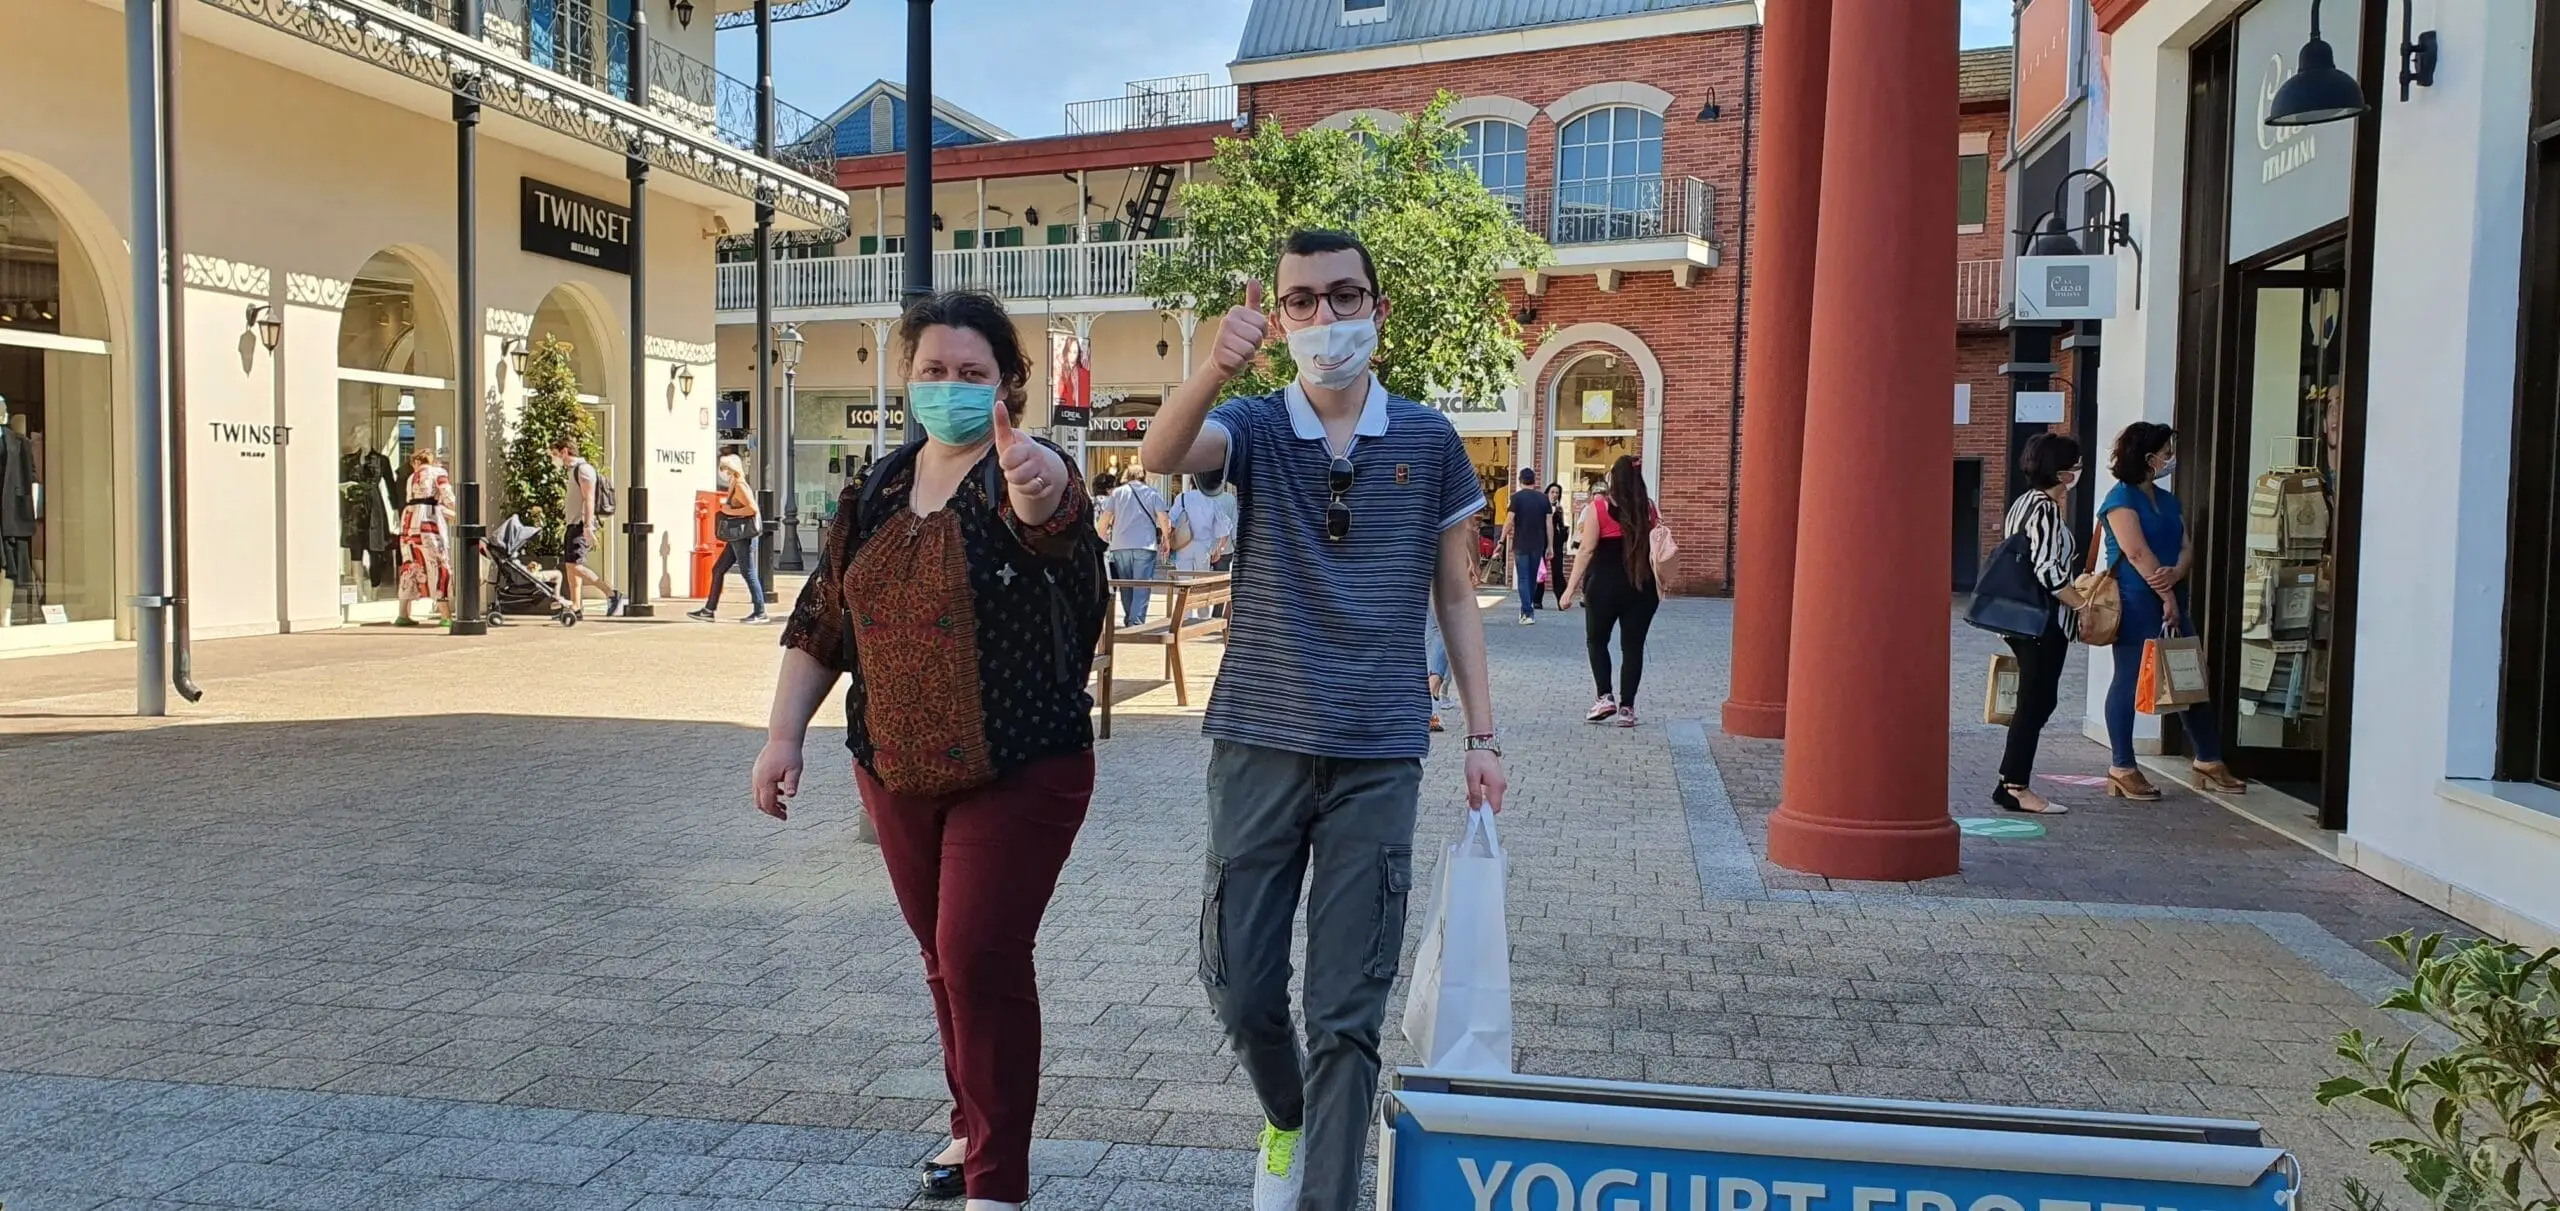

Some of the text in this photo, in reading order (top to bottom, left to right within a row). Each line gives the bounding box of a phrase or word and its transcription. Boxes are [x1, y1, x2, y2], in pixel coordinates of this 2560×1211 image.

[533, 189, 632, 246] TWINSET
[569, 241, 600, 258] MILANO
[2050, 275, 2082, 292] Casa
[1433, 396, 1507, 413] XCELA
[208, 421, 294, 446] TWINSET
[655, 448, 696, 465] TWINSET
